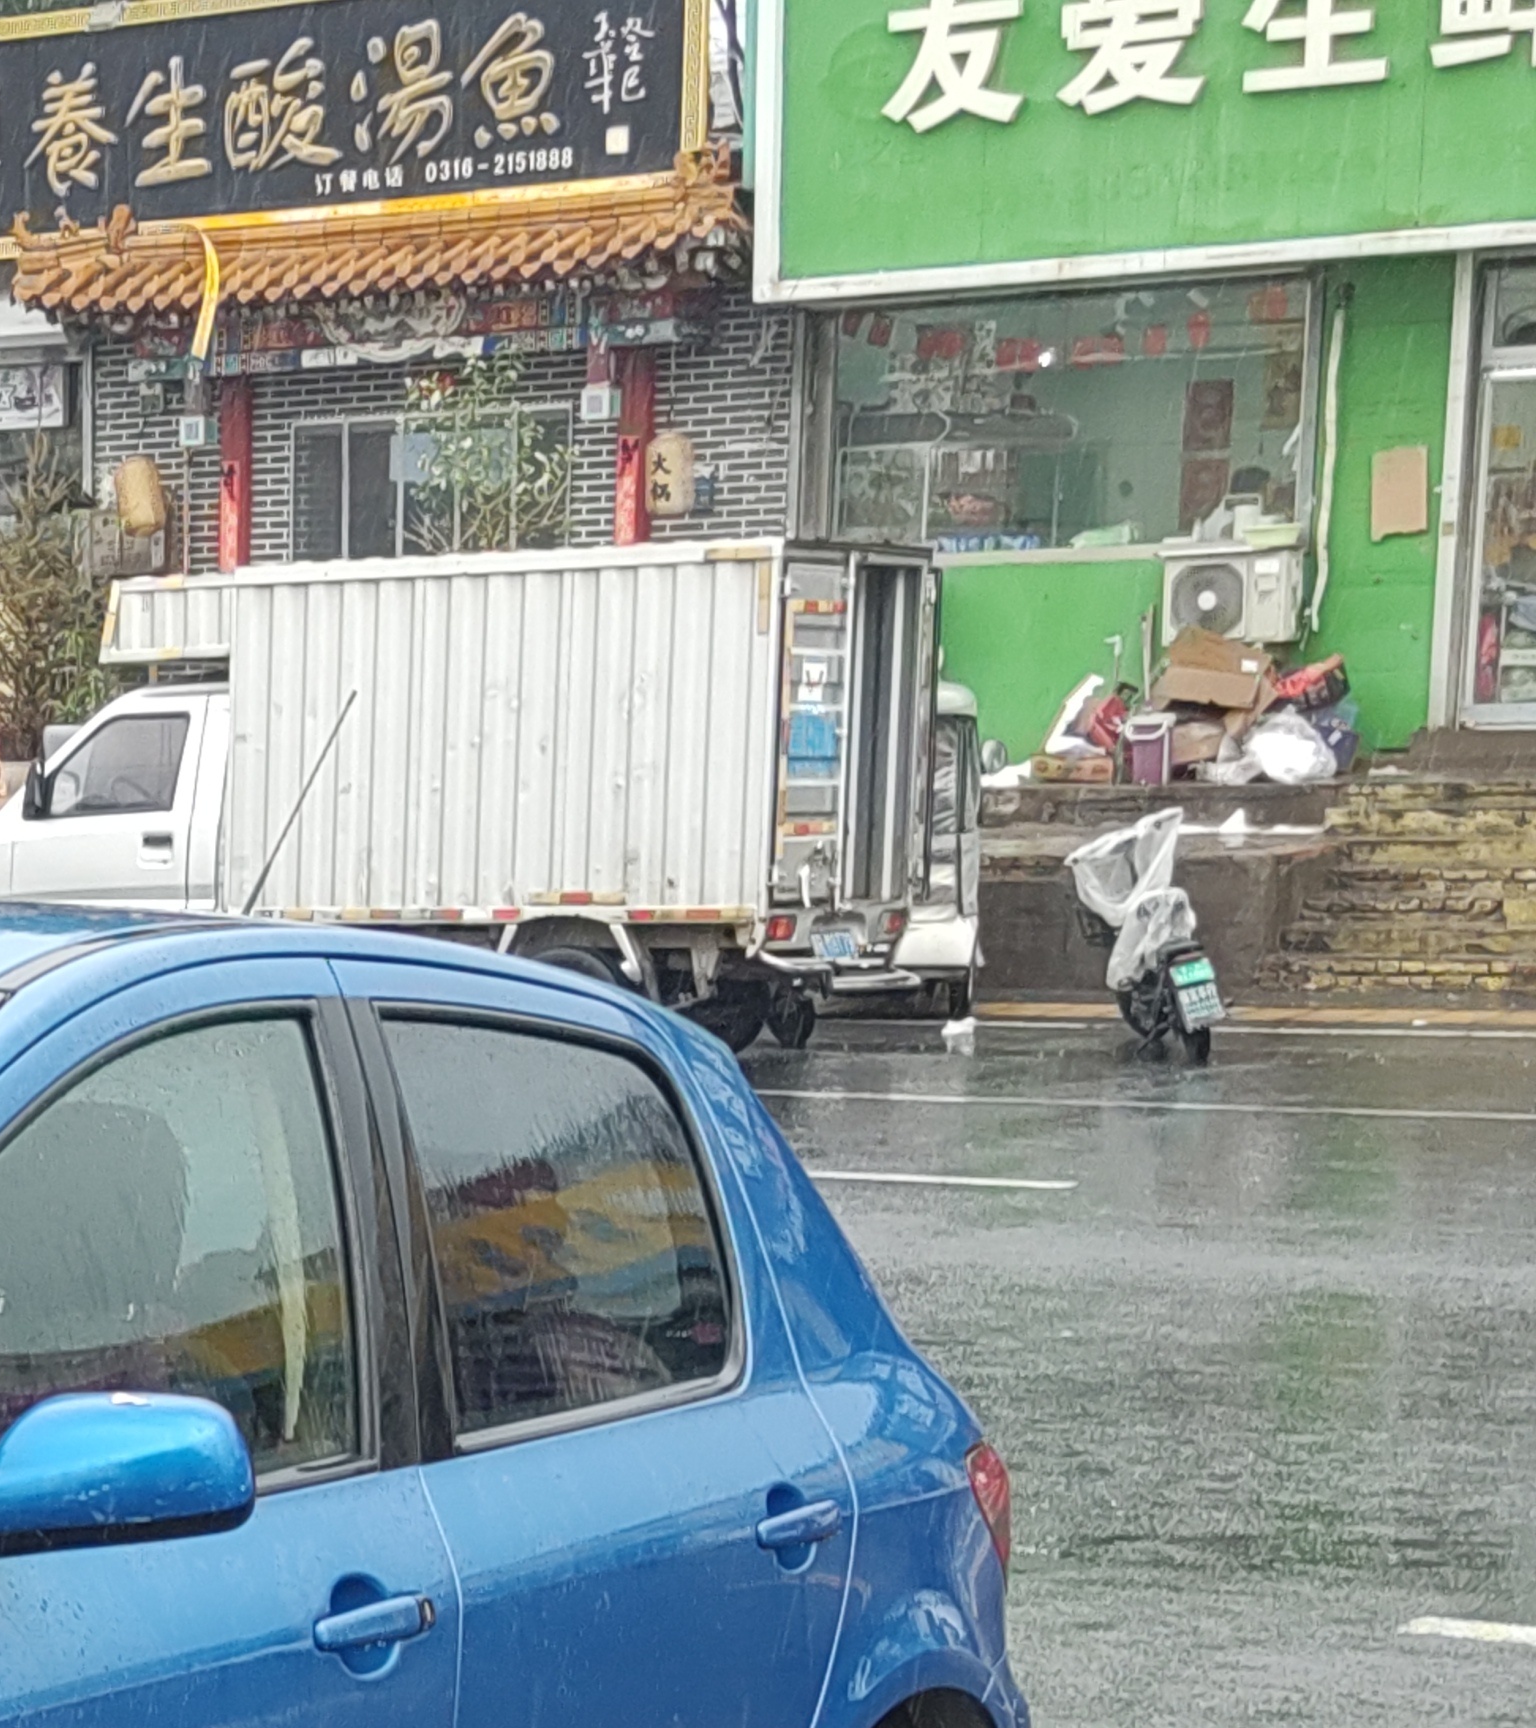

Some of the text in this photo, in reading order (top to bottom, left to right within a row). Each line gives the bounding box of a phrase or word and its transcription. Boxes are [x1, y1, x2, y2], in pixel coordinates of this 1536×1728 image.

[881, 0, 1536, 133] 友爱生
[314, 147, 574, 197] 订餐电话 0316-2151888
